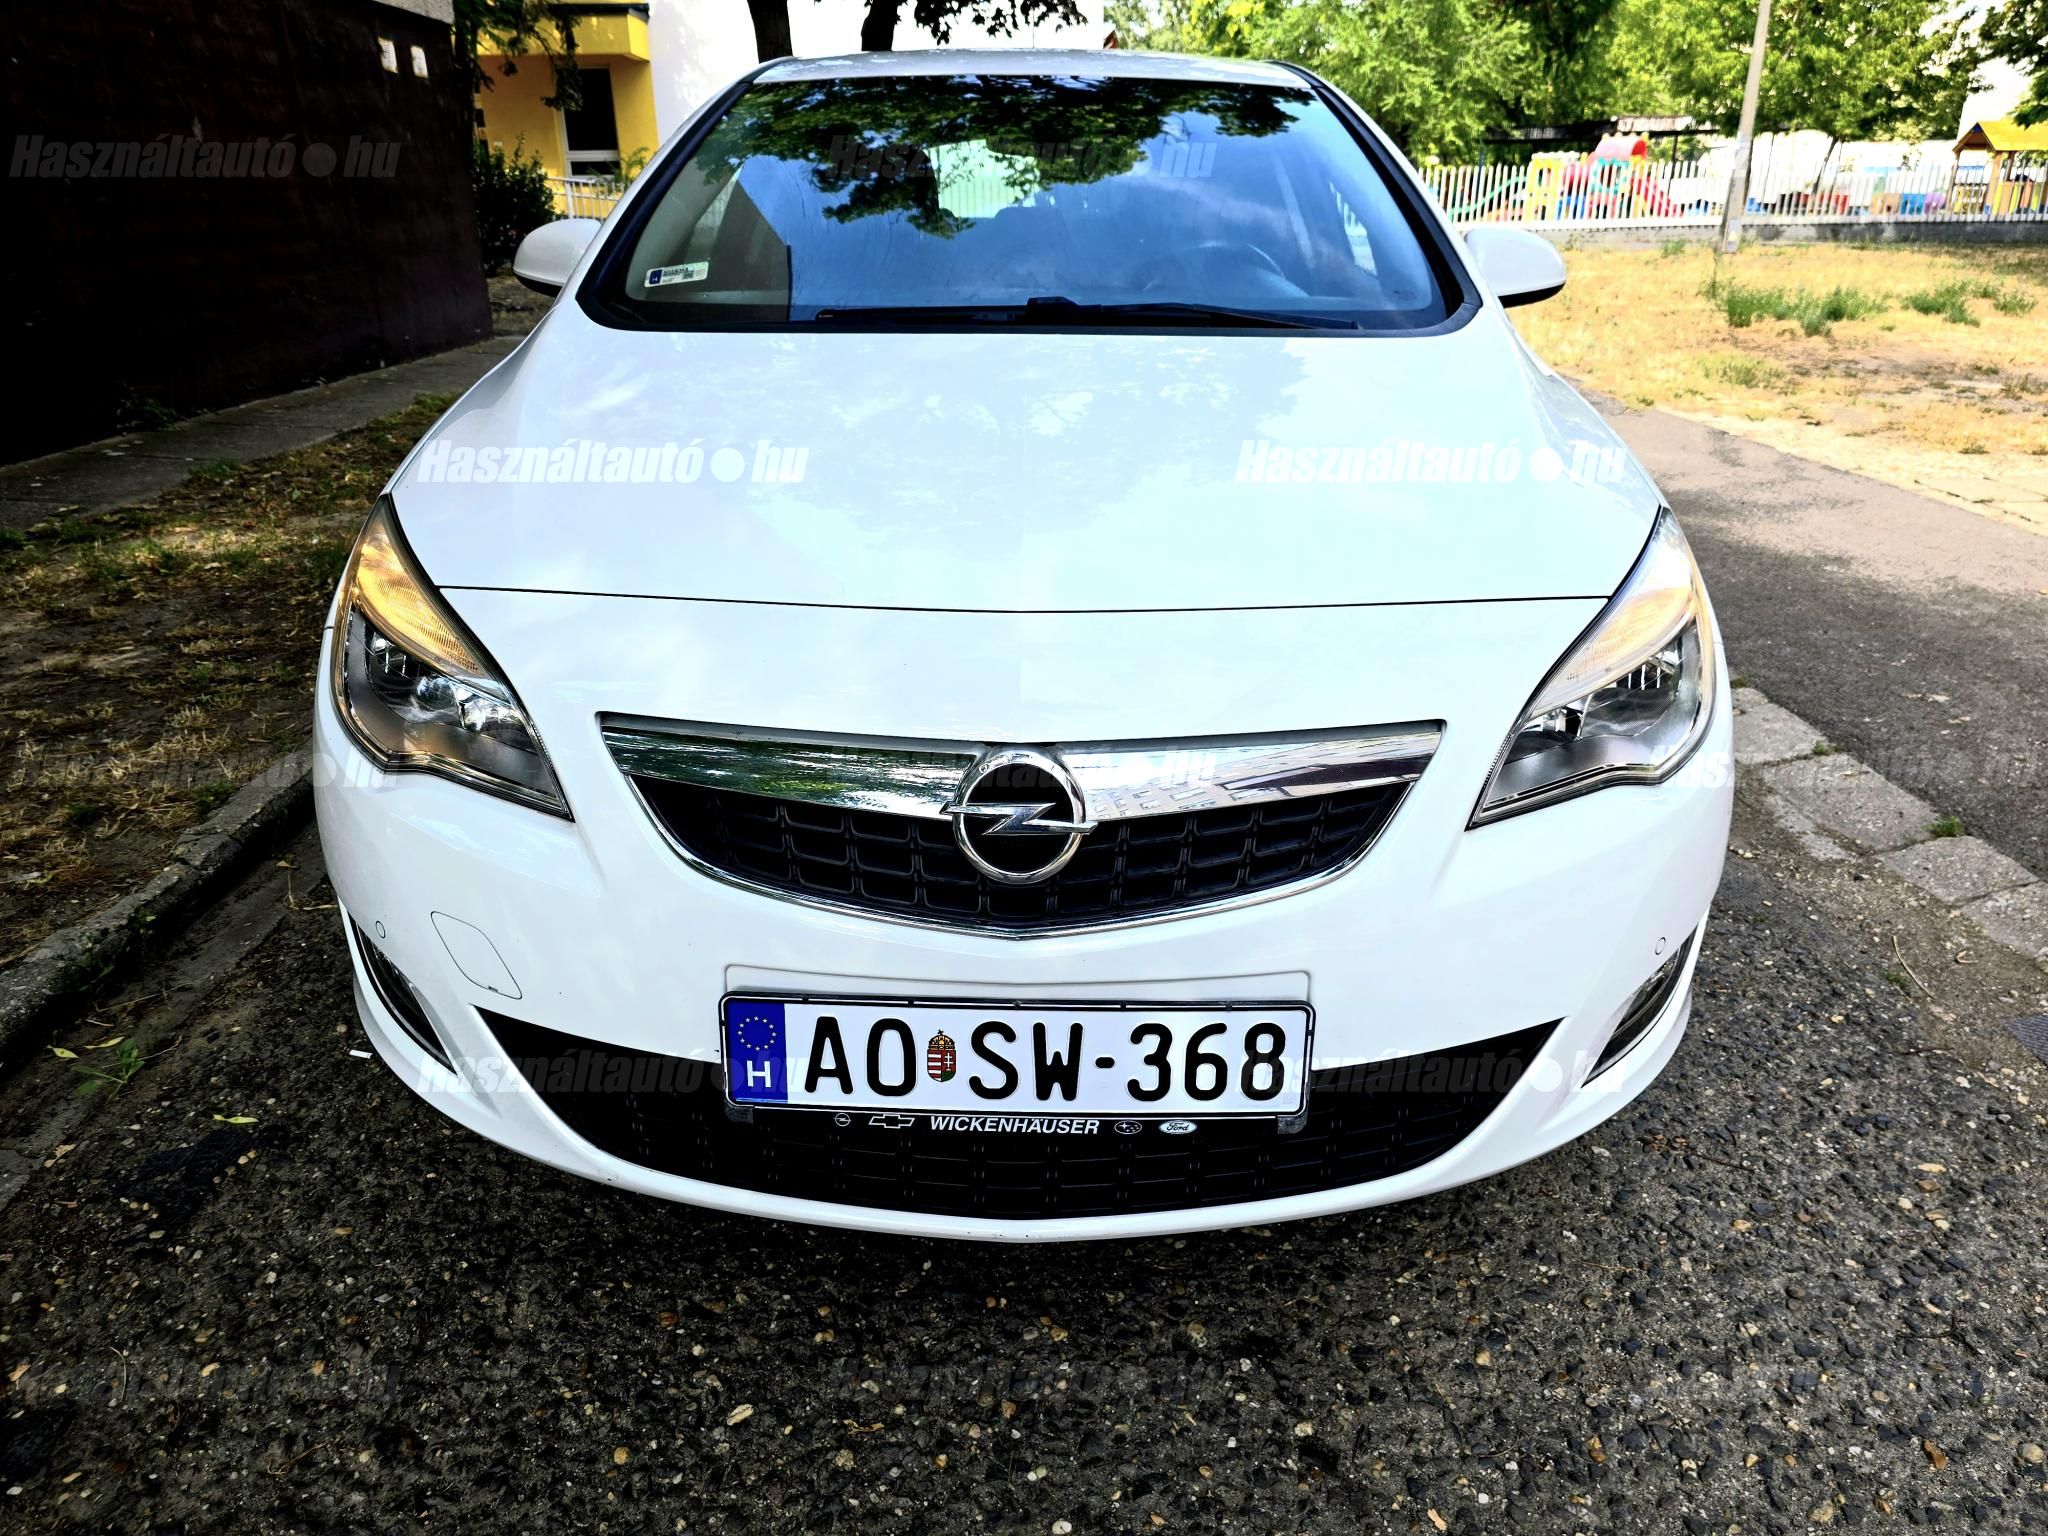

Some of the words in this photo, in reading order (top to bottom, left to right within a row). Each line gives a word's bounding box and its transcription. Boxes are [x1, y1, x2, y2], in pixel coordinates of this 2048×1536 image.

[804, 1016, 917, 1097] AO
[968, 1020, 1286, 1101] SW-368
[746, 1060, 772, 1088] H
[930, 1115, 1100, 1135] WICKENHÄUSER
